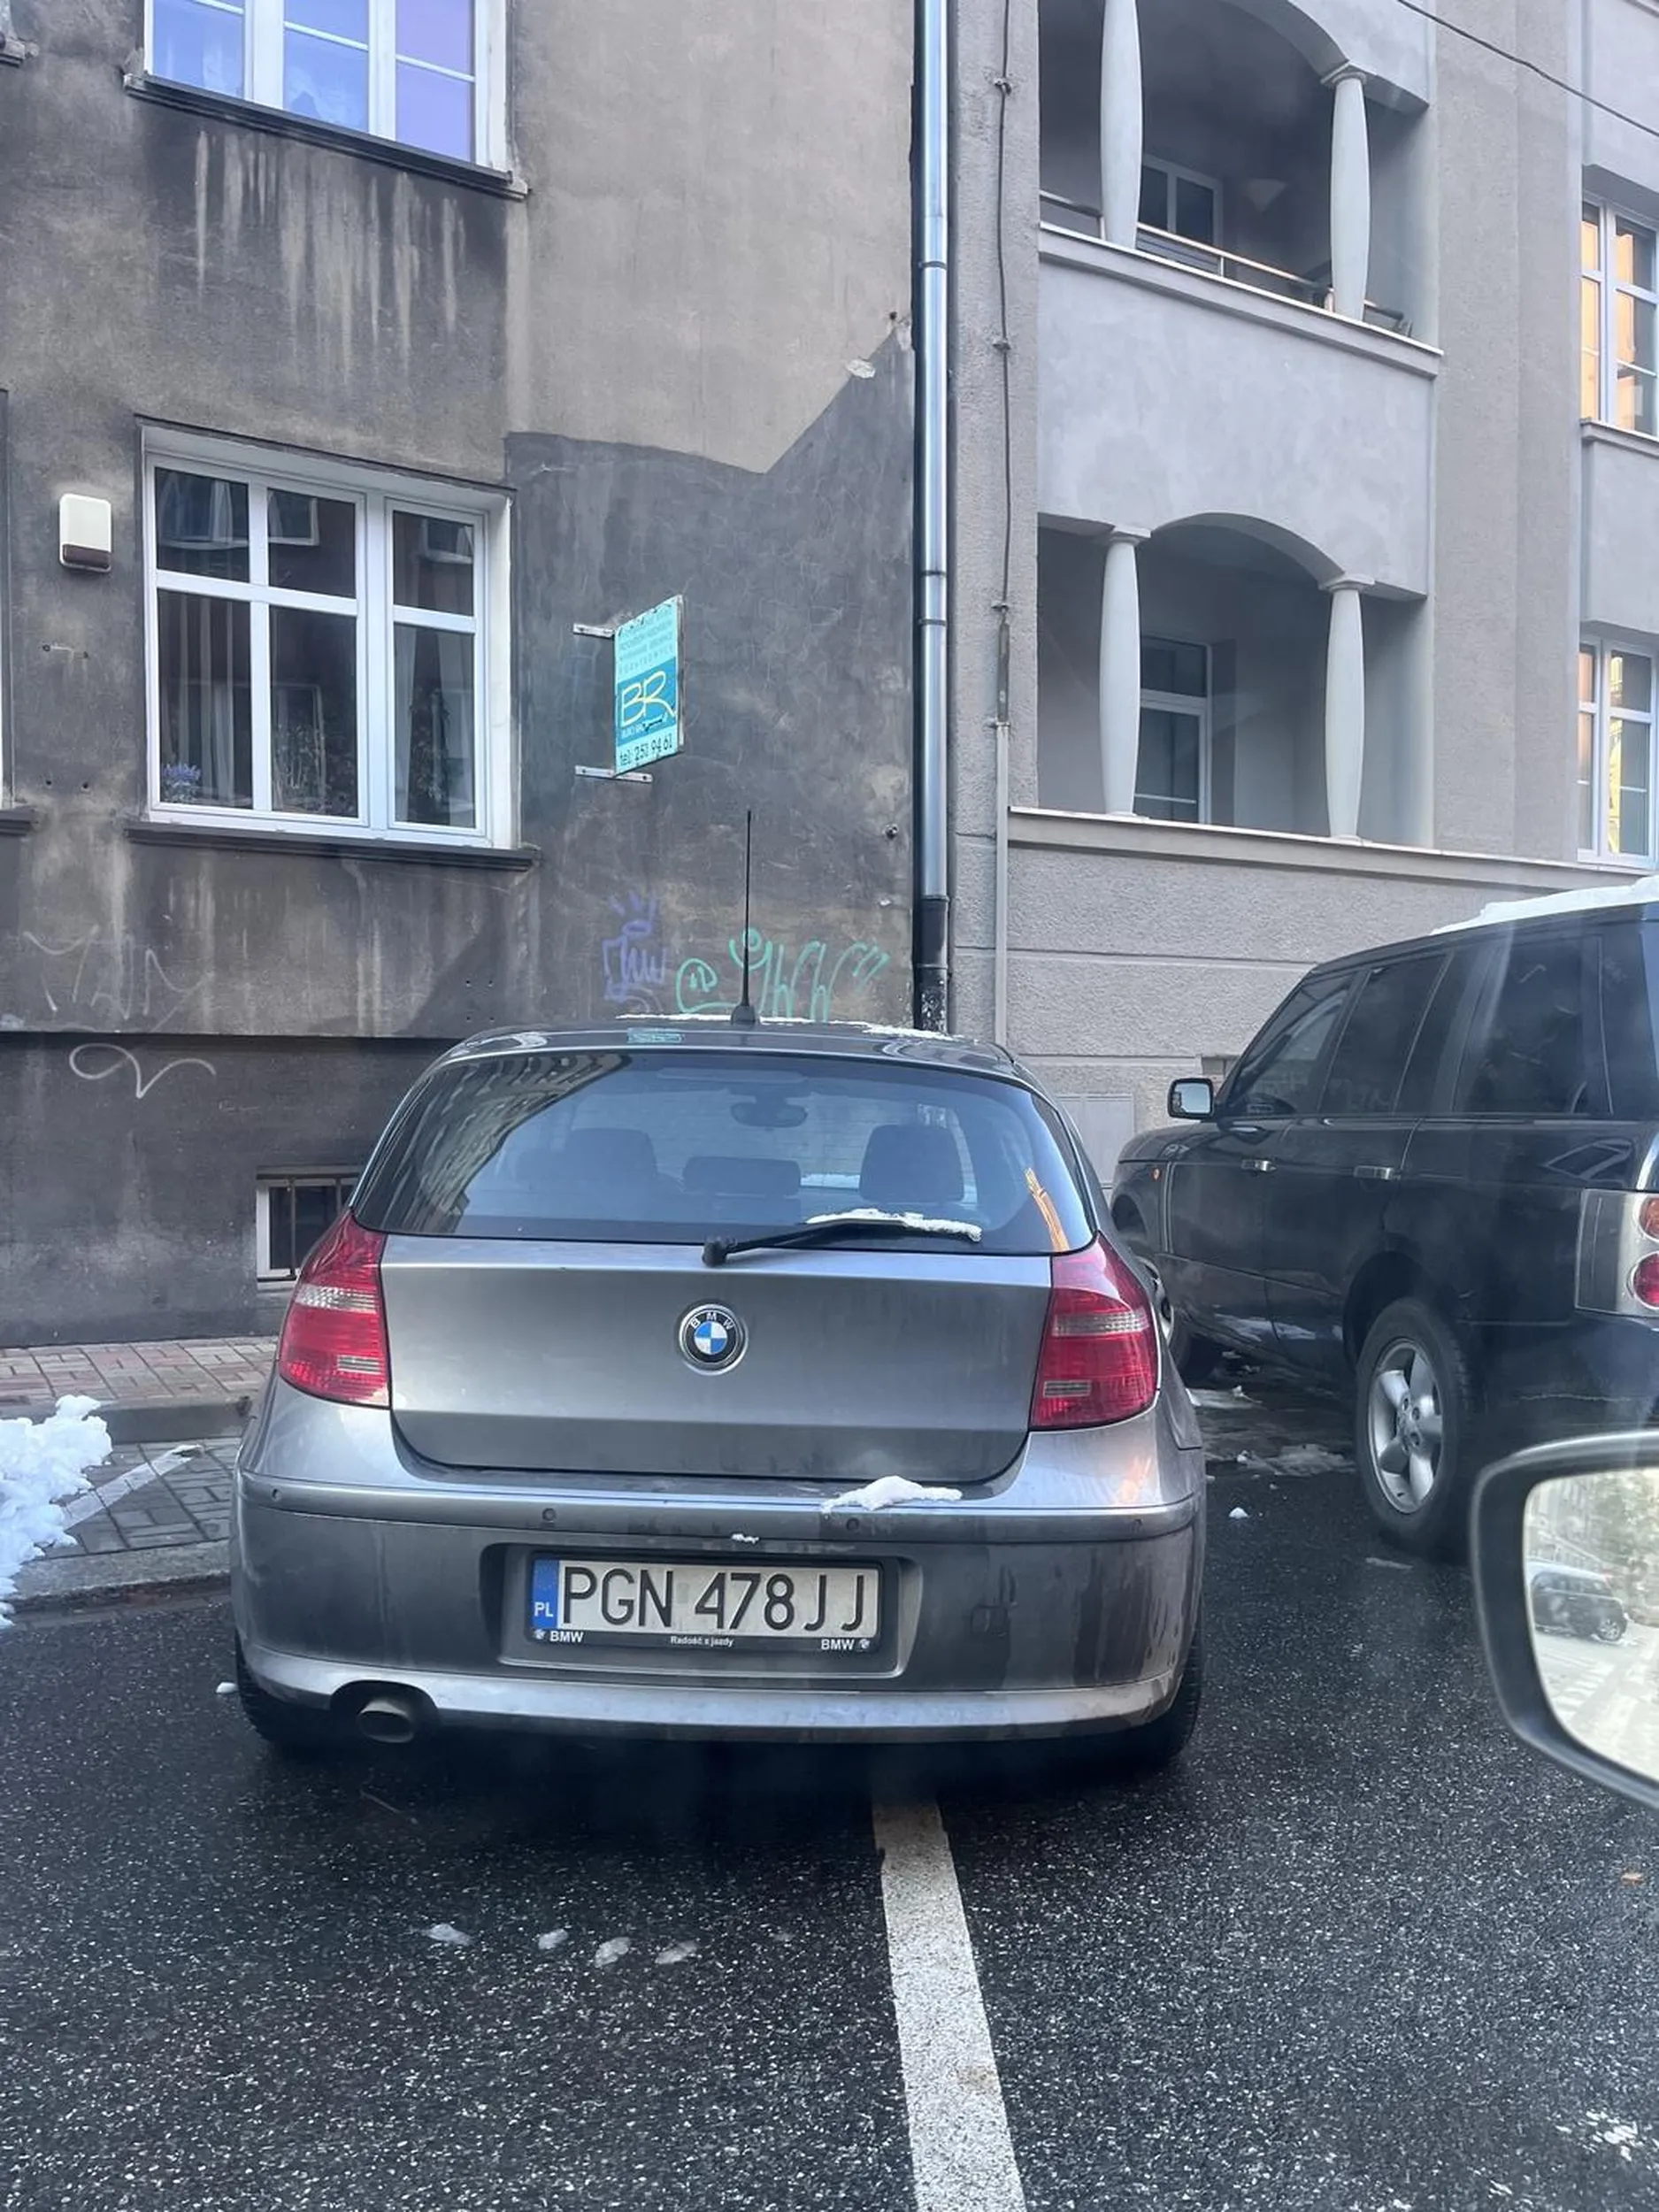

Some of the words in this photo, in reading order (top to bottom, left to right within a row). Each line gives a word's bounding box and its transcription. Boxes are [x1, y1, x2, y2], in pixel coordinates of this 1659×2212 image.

[621, 671, 677, 729] BR
[689, 1311, 734, 1330] BMW
[563, 1566, 674, 1628] PGN
[695, 1572, 865, 1632] 478JJ
[534, 1601, 554, 1617] PL
[549, 1631, 584, 1643] BMW
[710, 1636, 734, 1647] jazdy
[821, 1639, 855, 1651] BMW
